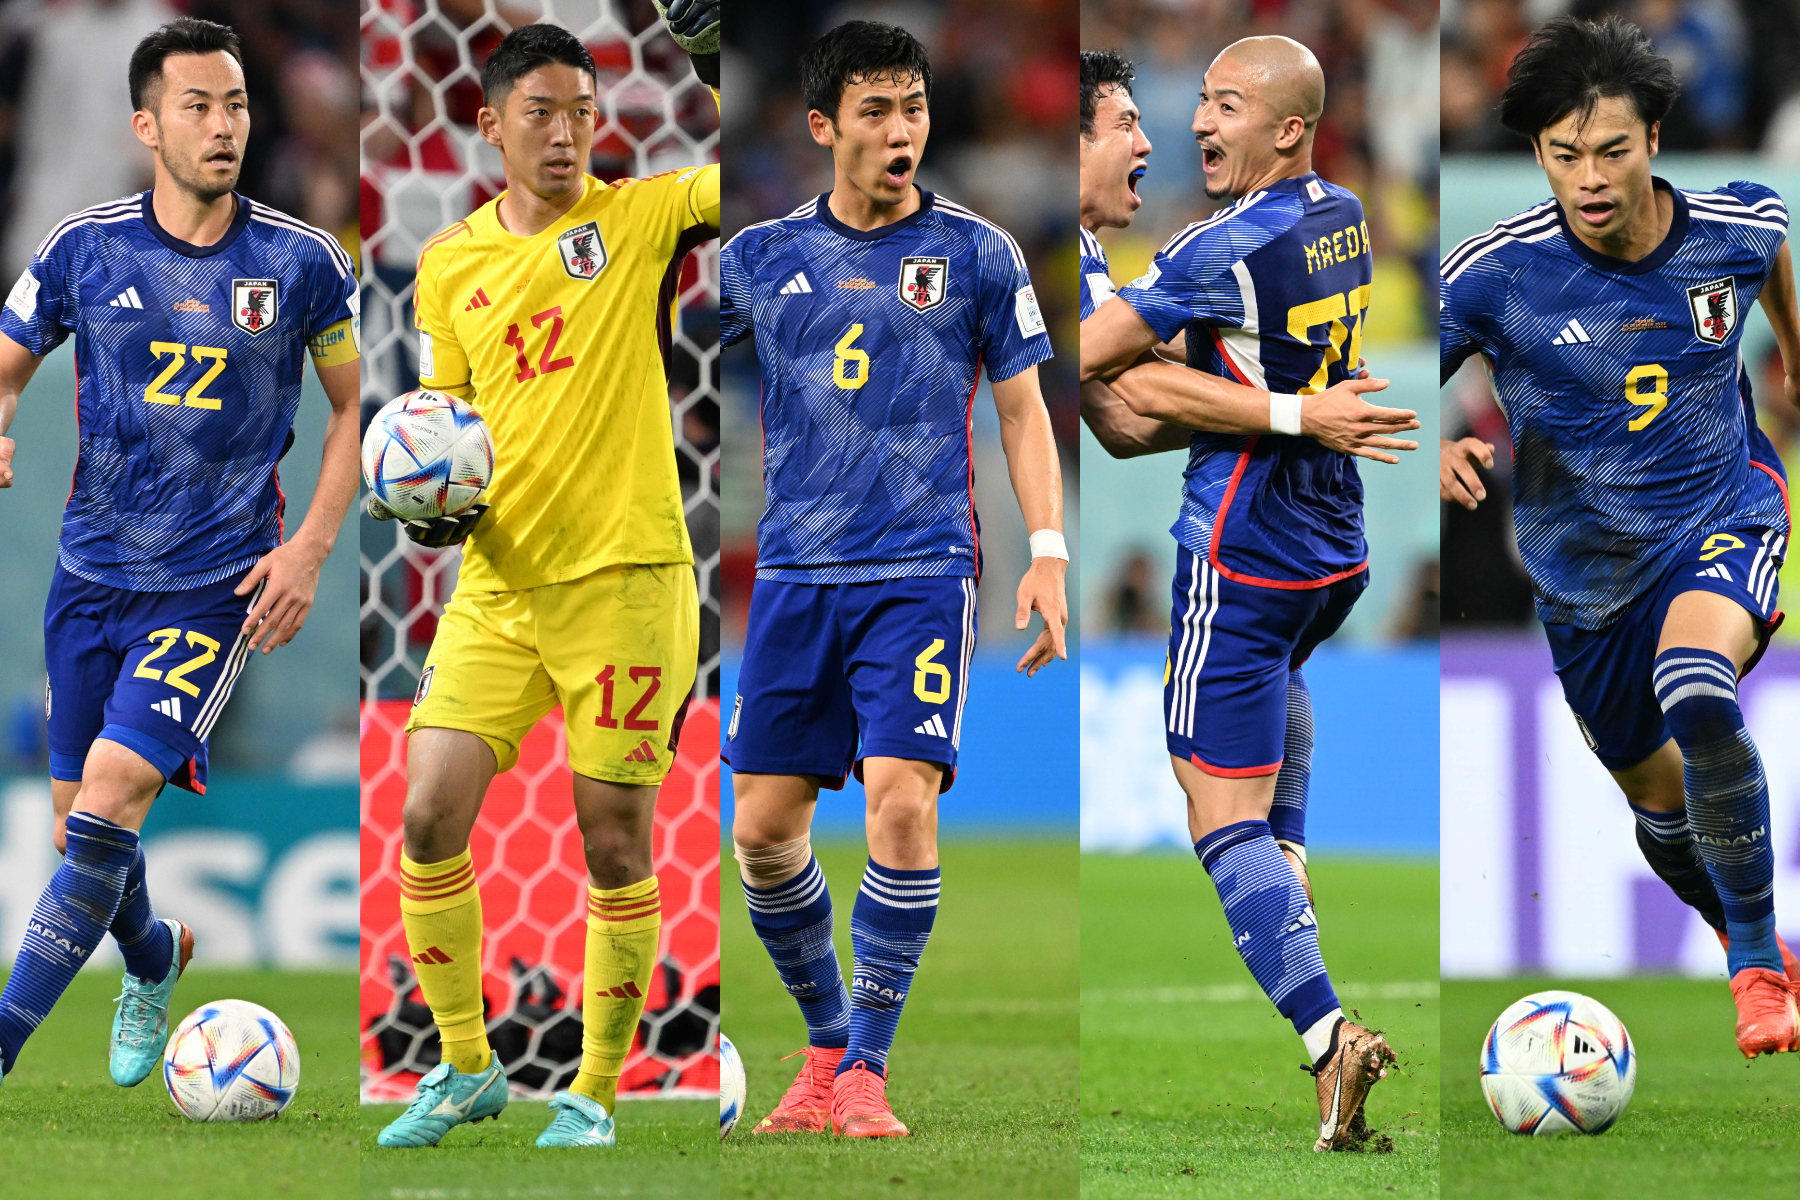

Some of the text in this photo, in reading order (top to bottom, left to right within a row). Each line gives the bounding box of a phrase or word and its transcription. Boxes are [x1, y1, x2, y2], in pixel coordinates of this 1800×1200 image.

[566, 226, 587, 237] JAPAN
[1303, 220, 1371, 274] MAEDA
[579, 260, 597, 274] JFA
[911, 292, 931, 302] JFA
[1700, 282, 1724, 294] JAPAN
[245, 316, 264, 326] JFA
[1709, 322, 1728, 336] JFA
[504, 305, 575, 384] 12
[832, 323, 870, 390] 6
[143, 341, 228, 410] 22
[1625, 363, 1669, 432] 9
[1698, 533, 1746, 561] 9
[133, 628, 221, 698] 22
[913, 638, 951, 705] 6
[594, 664, 662, 731] 12
[1692, 825, 1766, 847] JAPAN
[28, 919, 87, 958] JAPAN
